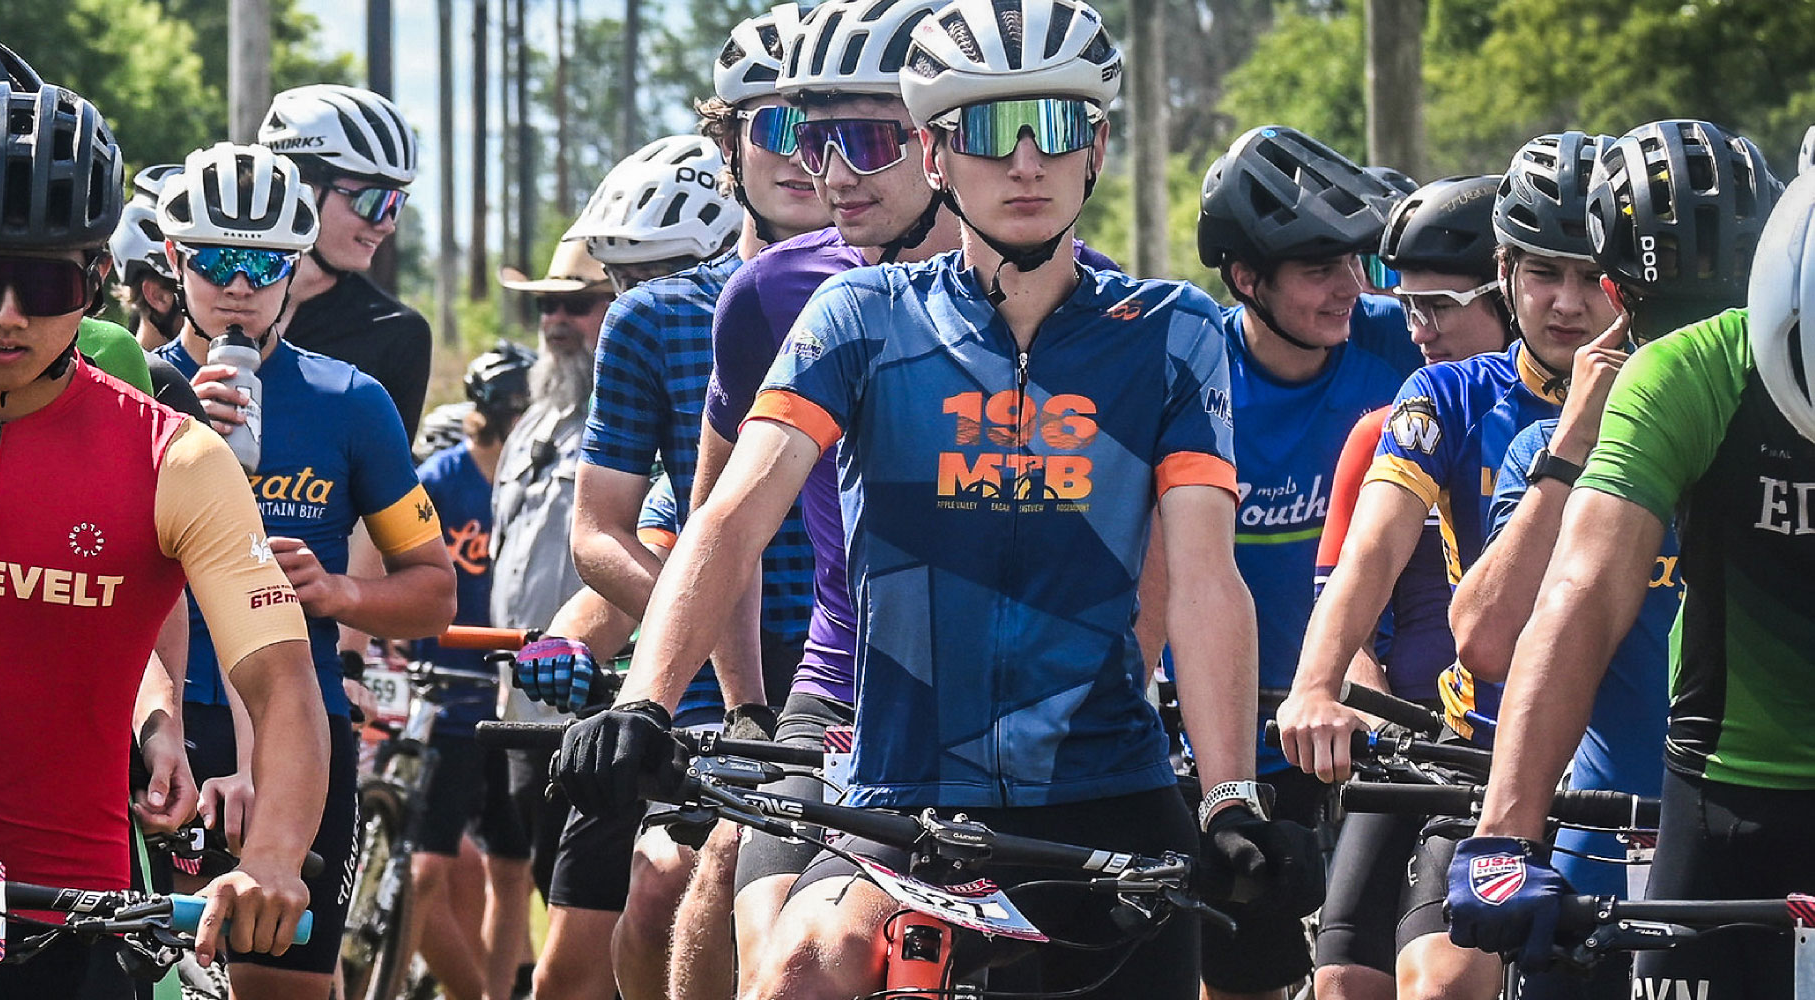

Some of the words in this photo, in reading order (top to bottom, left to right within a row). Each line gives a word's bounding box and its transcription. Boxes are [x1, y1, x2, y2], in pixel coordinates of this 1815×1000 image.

[942, 389, 1099, 450] 196
[937, 452, 1093, 500] MTB
[300, 504, 326, 519] BIKE
[1478, 857, 1517, 868] USA
[1477, 866, 1518, 875] CYCLING
